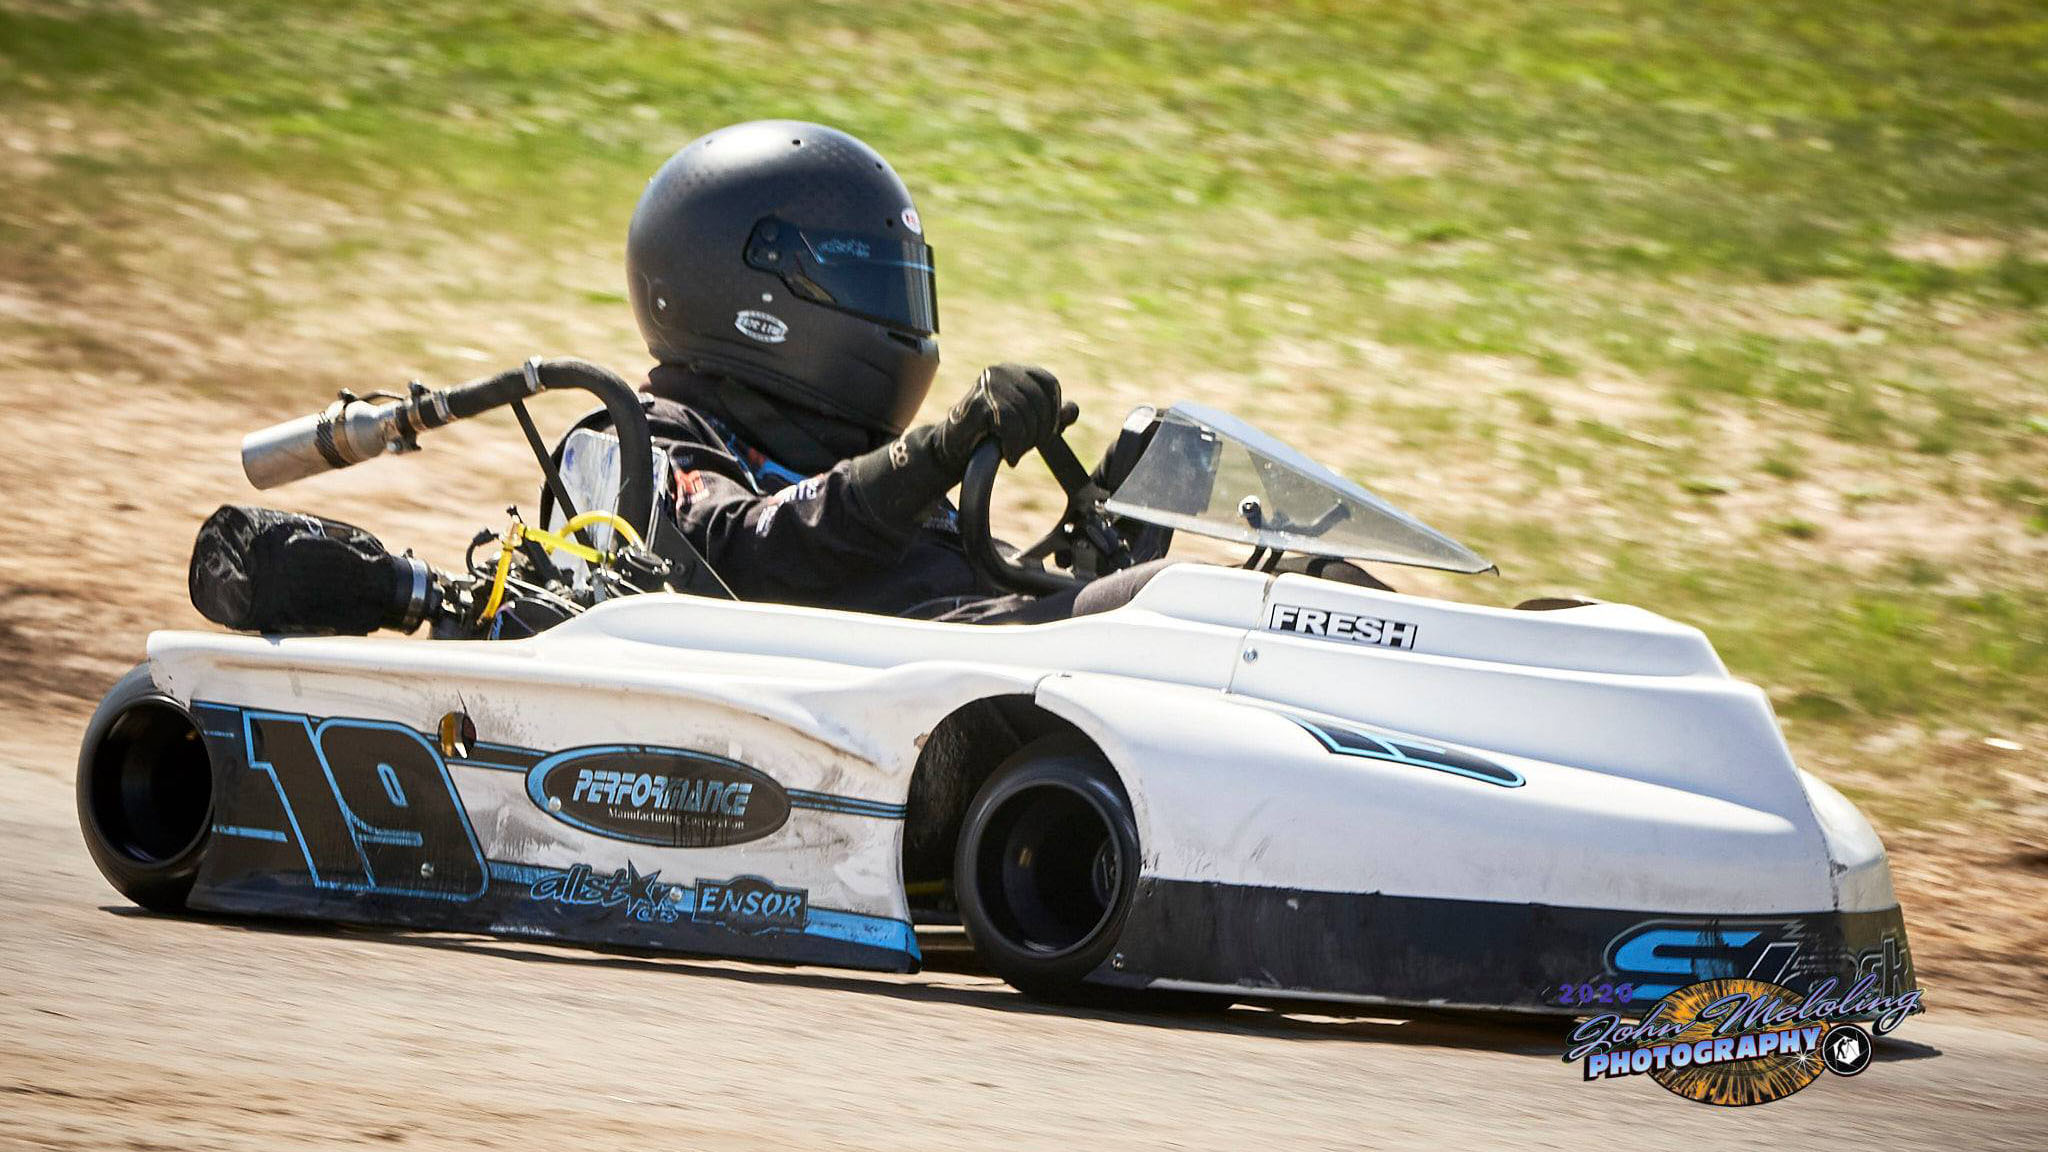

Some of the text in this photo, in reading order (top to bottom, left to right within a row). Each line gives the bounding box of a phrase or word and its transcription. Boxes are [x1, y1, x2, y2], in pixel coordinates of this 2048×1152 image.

[1271, 604, 1417, 650] FRESH
[241, 709, 490, 902] 19
[572, 768, 753, 817] PERFORMANCE
[608, 806, 682, 826] Manufacturing
[699, 886, 803, 920] ENSOR
